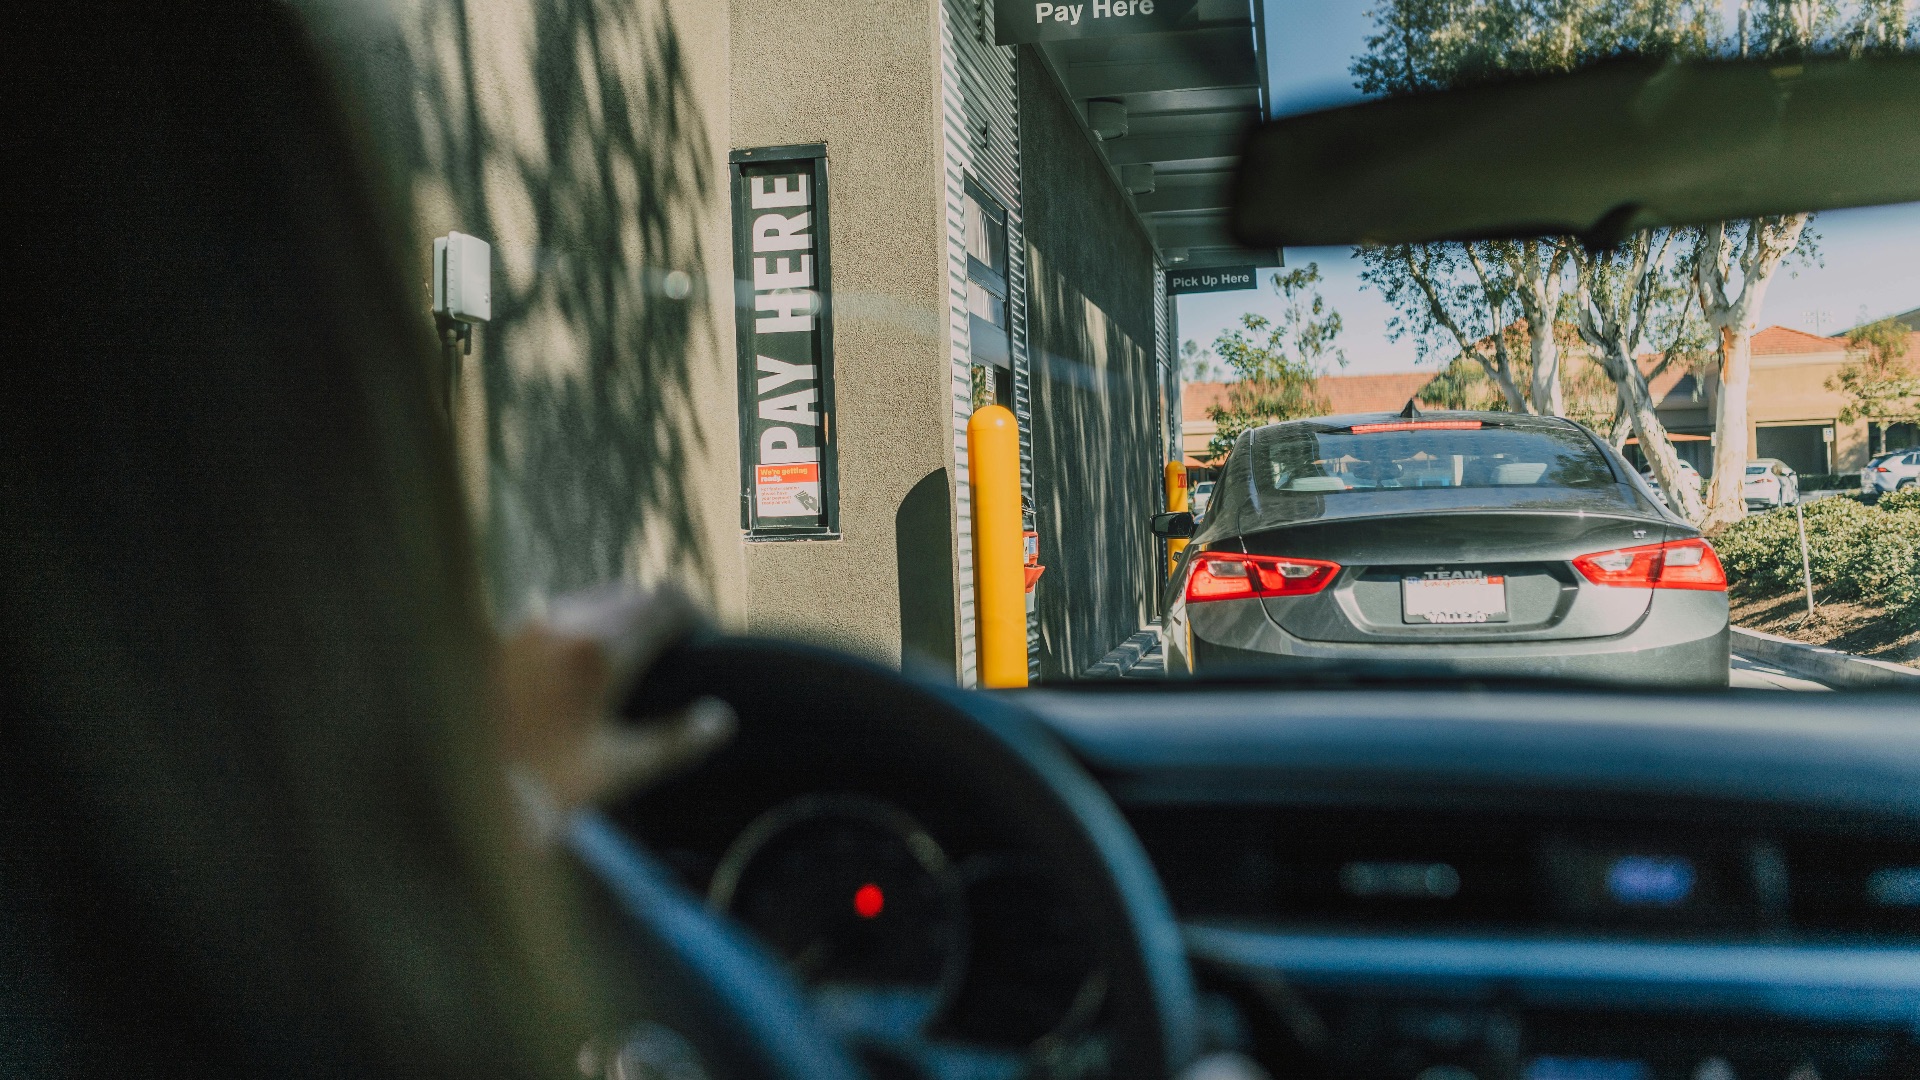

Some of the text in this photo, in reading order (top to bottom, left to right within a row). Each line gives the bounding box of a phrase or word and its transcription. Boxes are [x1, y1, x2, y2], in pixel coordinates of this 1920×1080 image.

[1035, 0, 1155, 25] Pay Here
[752, 173, 816, 334] HERE
[1172, 273, 1250, 288] Pick Up Here
[756, 354, 820, 465] PAY
[760, 467, 808, 476] We're getting
[1423, 570, 1483, 580] TEAM
